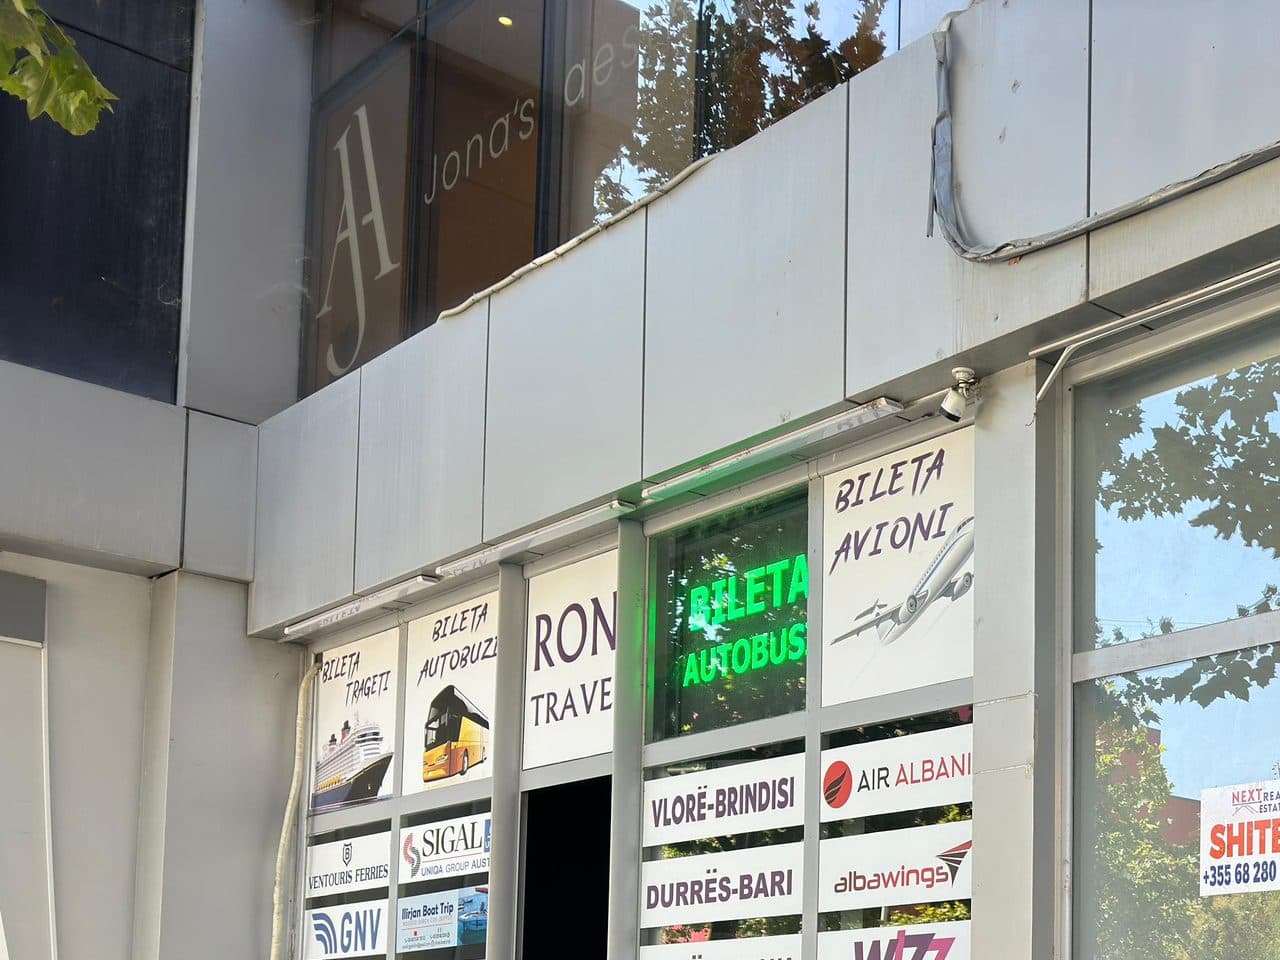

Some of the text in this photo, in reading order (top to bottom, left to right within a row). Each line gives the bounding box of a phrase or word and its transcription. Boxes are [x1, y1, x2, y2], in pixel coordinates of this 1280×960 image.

[835, 447, 945, 513] BILETA
[829, 502, 954, 576] AVIONI
[690, 553, 810, 633] BILETA
[432, 602, 488, 642] BILETA
[533, 590, 618, 672] RON
[322, 651, 360, 684] BILETA
[682, 621, 809, 688] AUTOBUS
[345, 670, 391, 706] TRAGETI
[530, 676, 613, 727] TRAVE
[857, 751, 971, 793] AIR ALBANI
[652, 776, 795, 828] VLORË-BRINDISI
[1232, 788, 1263, 804] NEXT
[422, 821, 483, 857] SIGAL
[309, 863, 389, 889] VENTOURIS FERRIES
[421, 864, 443, 877] UNIQA
[446, 862, 470, 873] GROUP
[646, 868, 793, 910] DURRËS-BARI
[834, 864, 948, 894] albawings
[1203, 864, 1231, 887] +355
[1234, 862, 1250, 885] 68
[1253, 860, 1277, 883] 280
[423, 903, 439, 917] Boat
[440, 901, 454, 915] Trip
[341, 907, 381, 954] GNV
